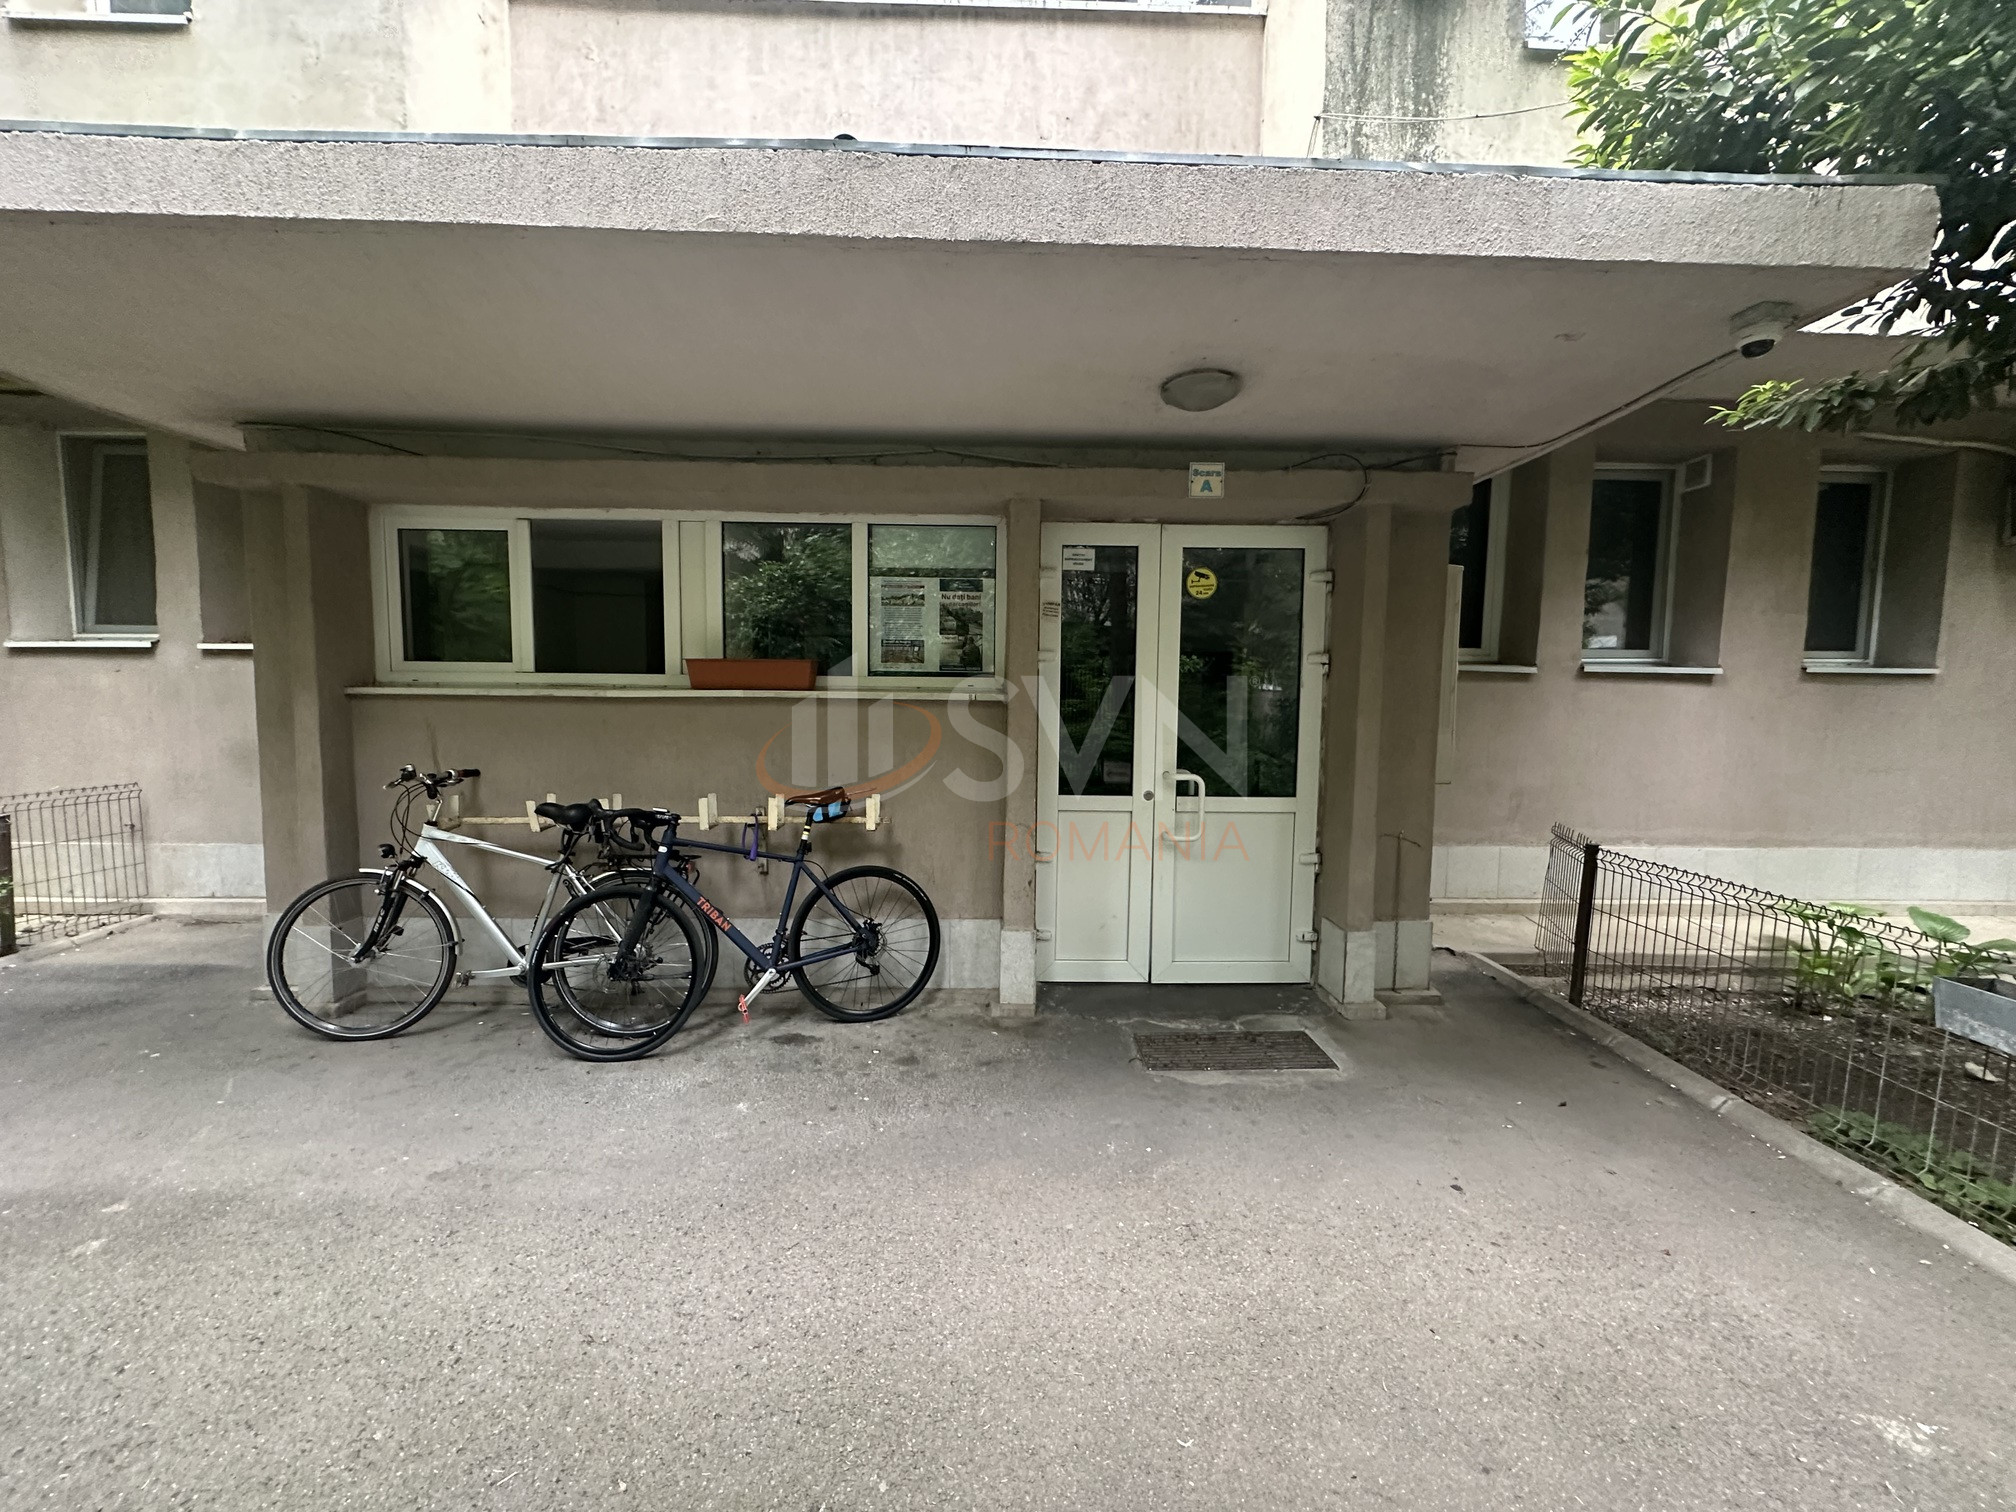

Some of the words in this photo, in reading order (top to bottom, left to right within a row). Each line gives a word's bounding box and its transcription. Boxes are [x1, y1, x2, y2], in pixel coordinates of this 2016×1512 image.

[1192, 468, 1222, 477] Scara
[1200, 479, 1213, 492] A
[696, 896, 732, 932] TRIBAN
